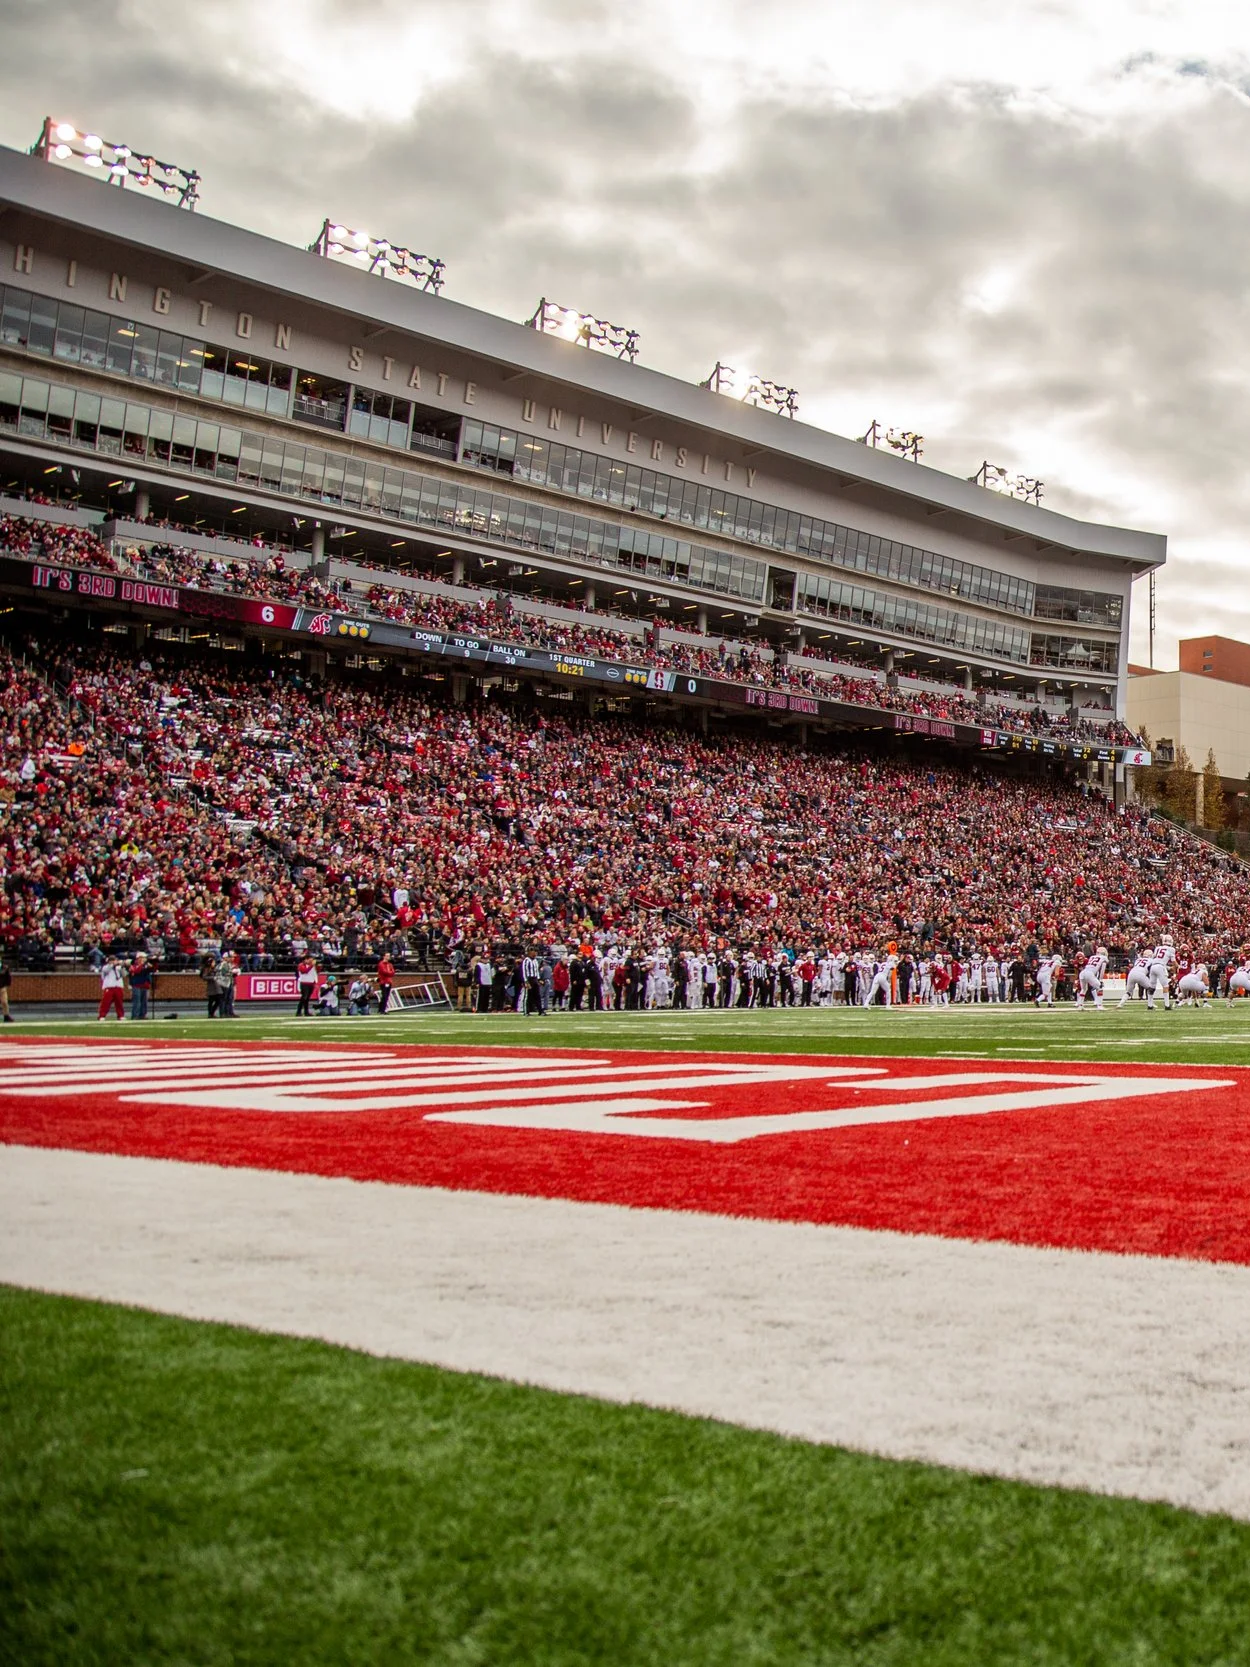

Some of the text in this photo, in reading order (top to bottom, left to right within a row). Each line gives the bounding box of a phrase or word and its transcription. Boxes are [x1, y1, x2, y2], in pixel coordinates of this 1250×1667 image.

[348, 345, 477, 405] STATE
[522, 400, 757, 488] UNIVERSITY
[33, 565, 179, 608] IT'S 3RD DOWN!
[262, 606, 274, 622] 6
[415, 632, 442, 643] DOWN
[454, 638, 479, 649] TO GO
[424, 643, 430, 651] 3
[464, 649, 470, 657] 9
[493, 645, 525, 657] BALL ON
[505, 656, 516, 664] 30
[564, 656, 595, 668] QUARTER
[556, 663, 584, 676] 10:21
[688, 679, 696, 692] 0
[746, 688, 819, 715] IT'S 3RD DOWN!
[894, 715, 955, 738] IT'S 3RD DOWN!
[1156, 949, 1167, 959] 15
